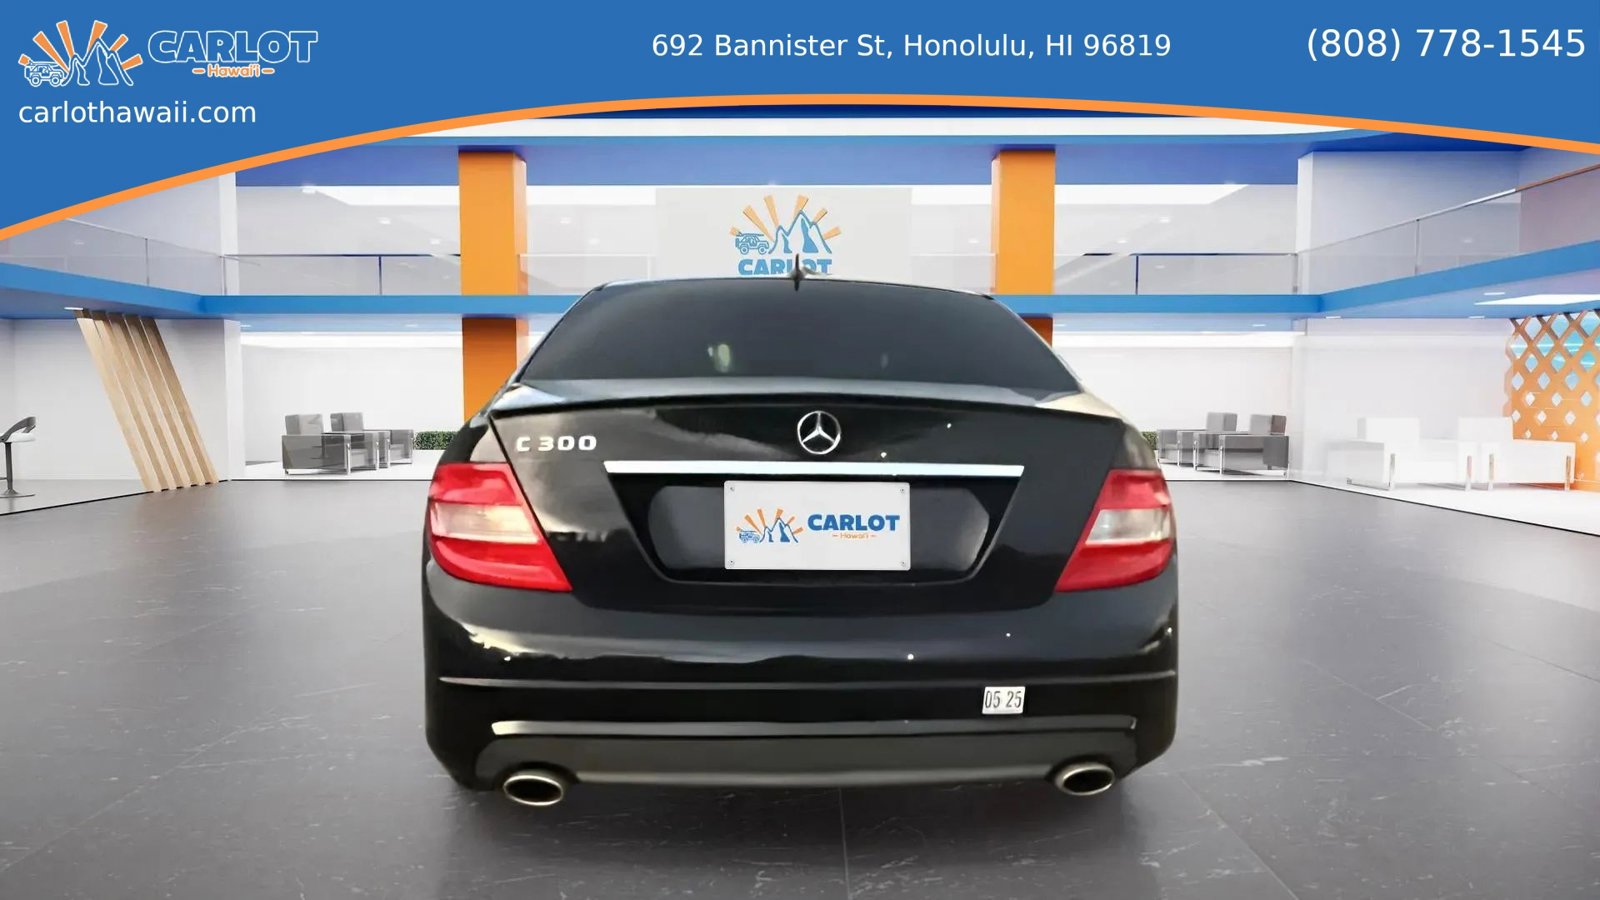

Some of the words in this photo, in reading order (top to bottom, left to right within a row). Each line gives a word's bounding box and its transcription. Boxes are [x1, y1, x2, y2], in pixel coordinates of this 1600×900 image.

[516, 435, 531, 452] C
[538, 434, 597, 452] 300
[807, 514, 901, 532] CARLOT
[985, 690, 1001, 709] 05
[1005, 690, 1022, 709] 25
